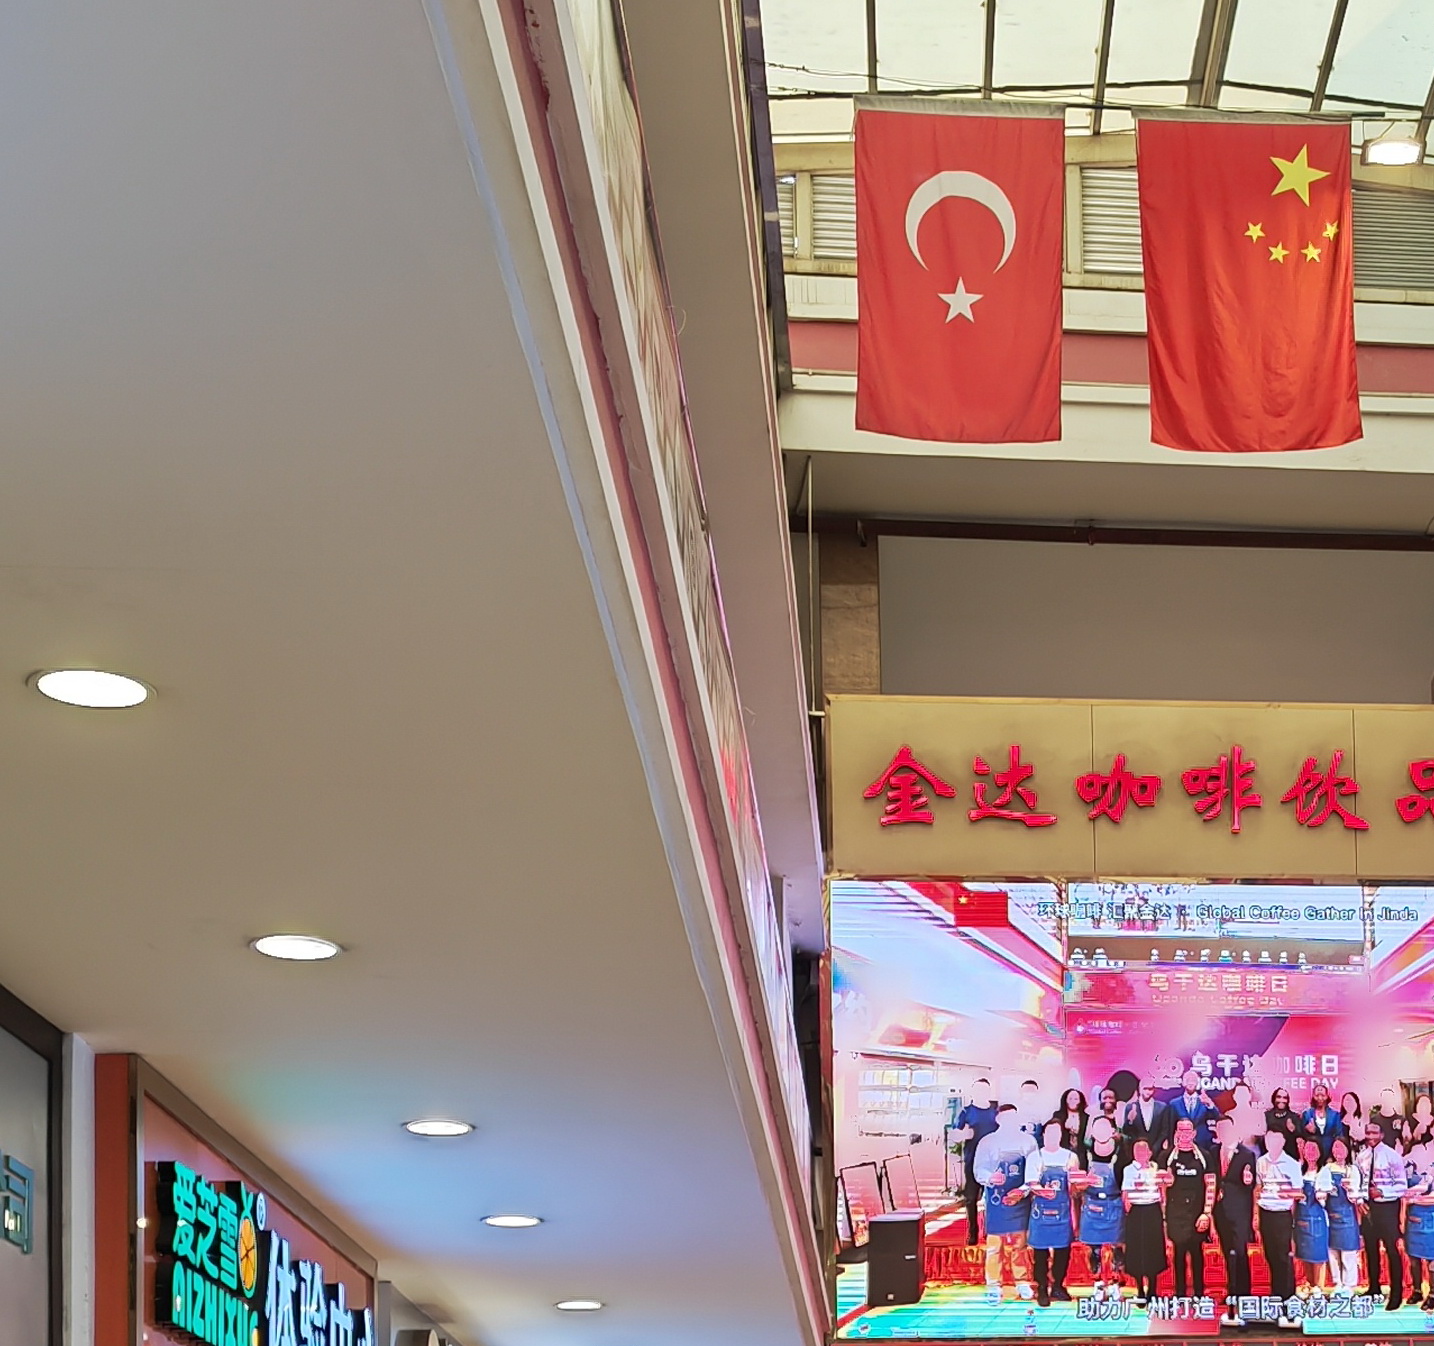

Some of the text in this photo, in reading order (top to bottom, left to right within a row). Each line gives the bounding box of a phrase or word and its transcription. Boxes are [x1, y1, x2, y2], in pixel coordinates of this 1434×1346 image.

[1196, 904, 1245, 920] Global
[1249, 905, 1301, 921] Coffee
[1304, 906, 1356, 922] Gather
[1378, 906, 1419, 923] Jinda
